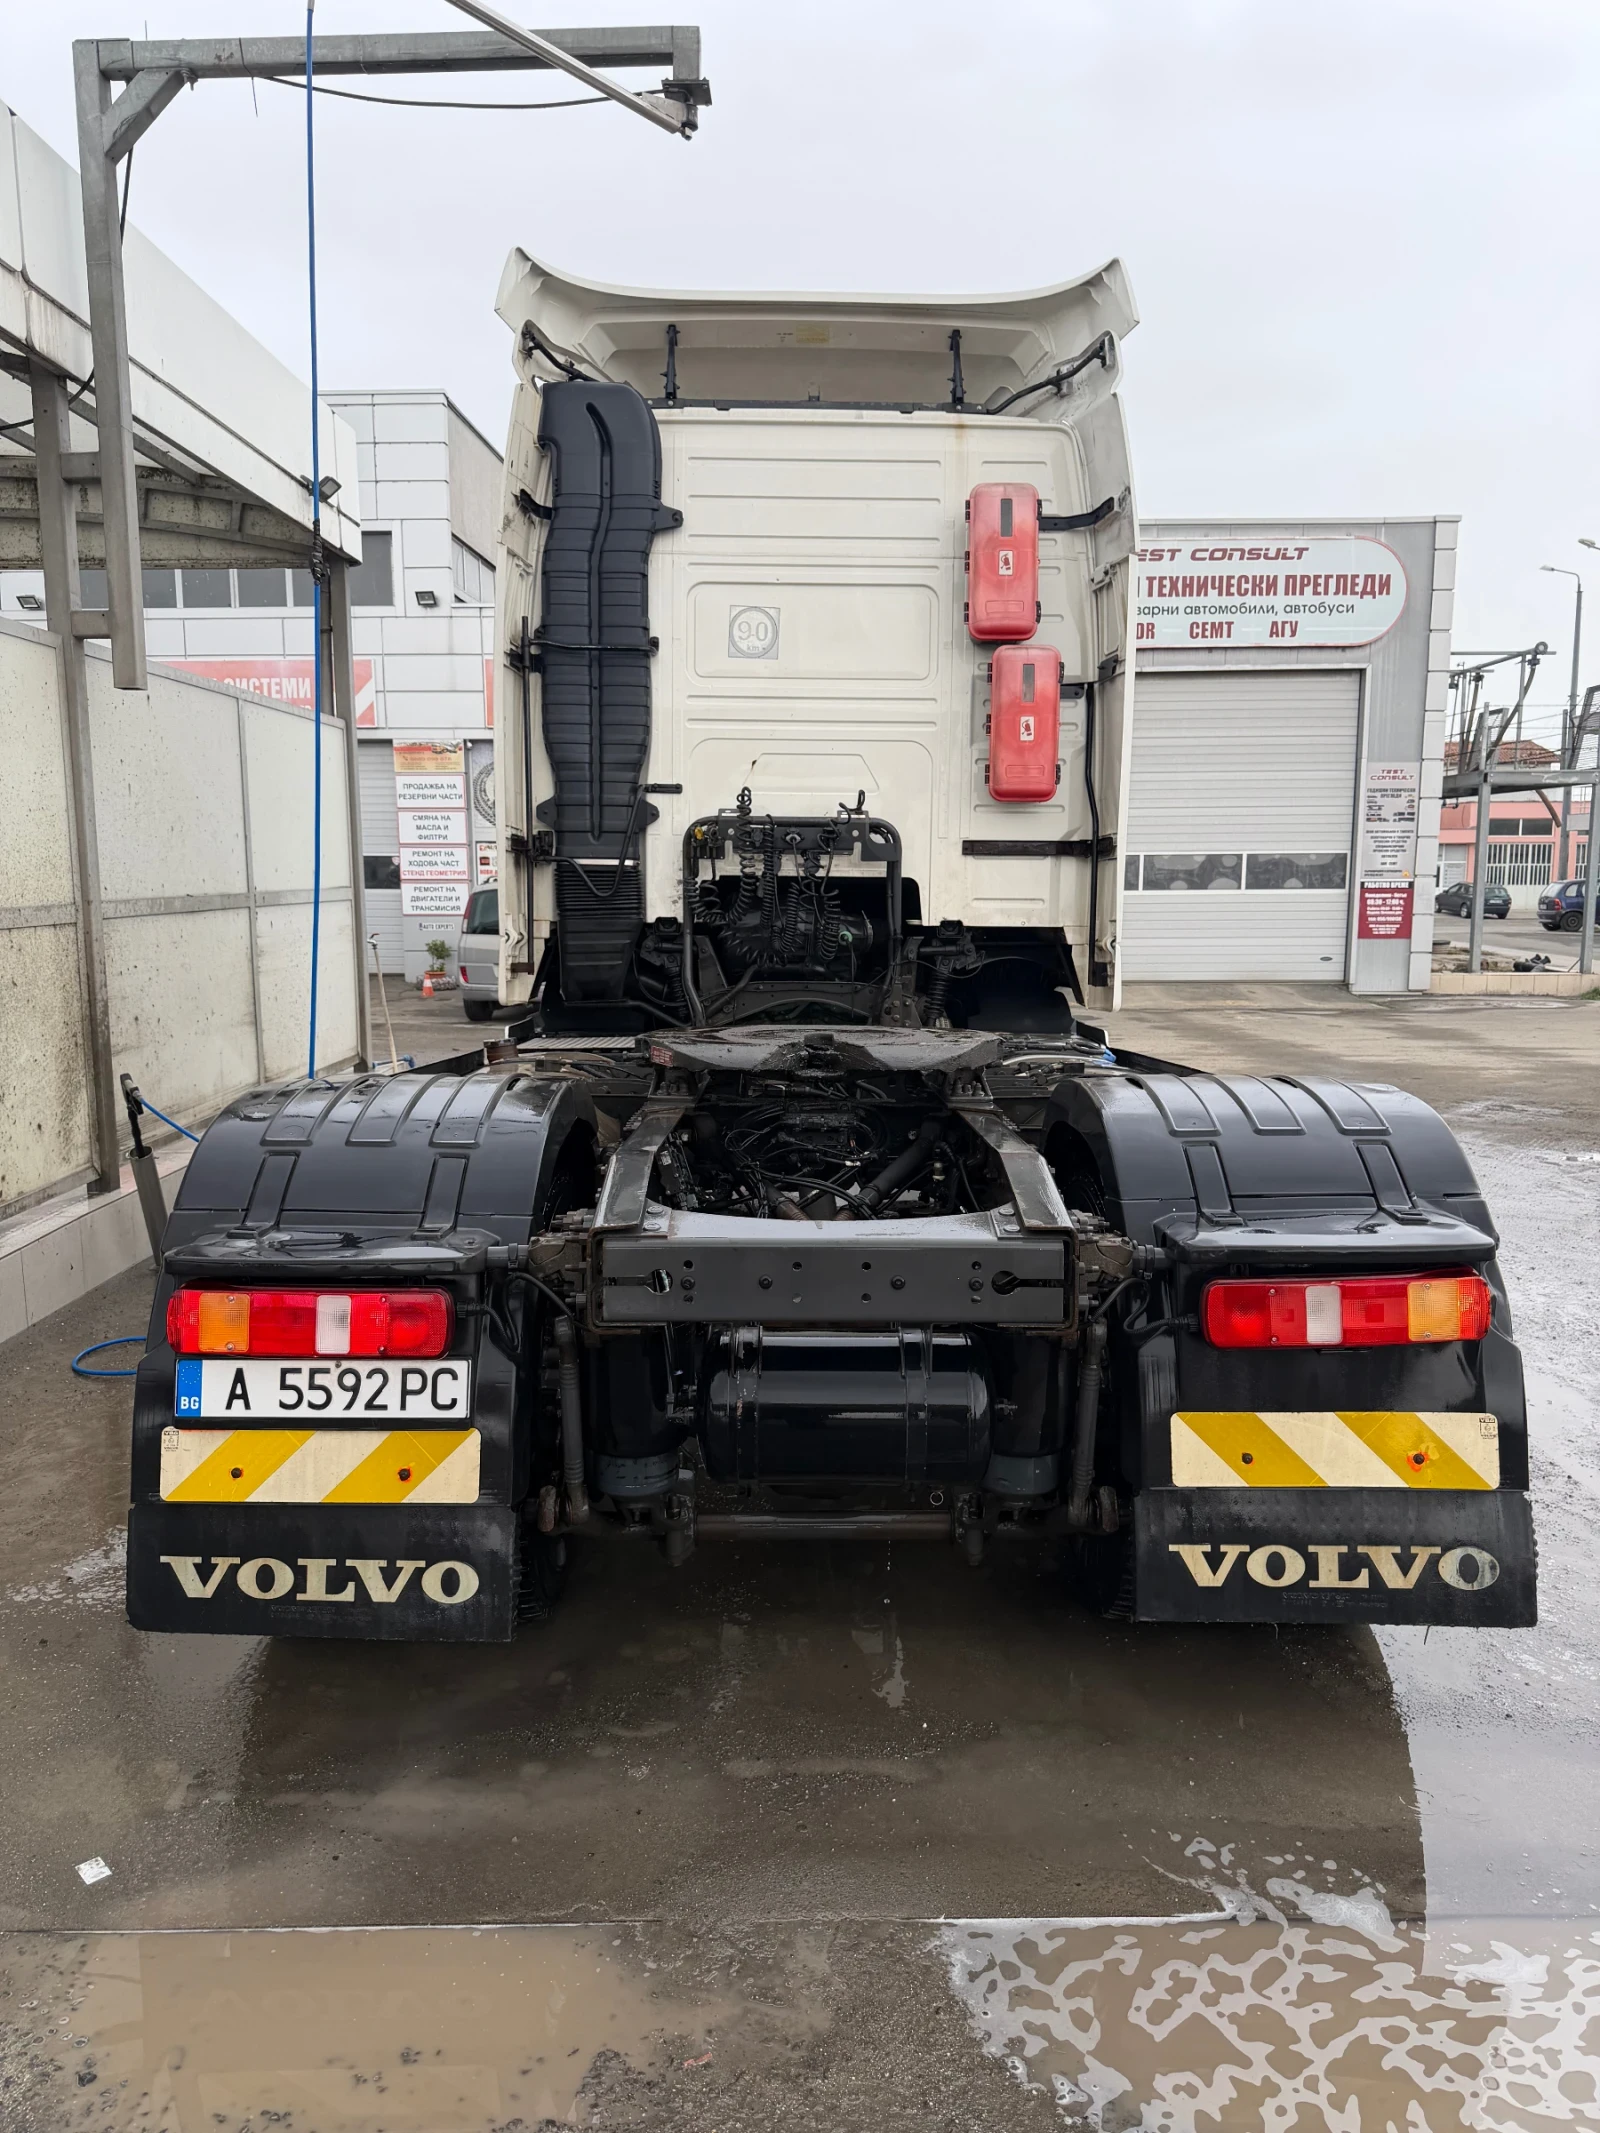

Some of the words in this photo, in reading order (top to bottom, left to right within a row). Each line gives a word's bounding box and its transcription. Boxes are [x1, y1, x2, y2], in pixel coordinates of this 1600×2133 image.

[1190, 546, 1309, 561] CONSULT
[1146, 574, 1278, 598] ТЕХНИЧЕСКИ
[1284, 573, 1392, 599] ПРЕГЛЕДИ
[1184, 602, 1278, 615] автомобили,
[1283, 601, 1355, 616] автобуси
[738, 620, 768, 642] 90
[1269, 620, 1298, 638] АГУ
[180, 1396, 200, 1410] BG
[1168, 1544, 1500, 1591] VOLVO
[160, 1555, 480, 1604] VOLVO
